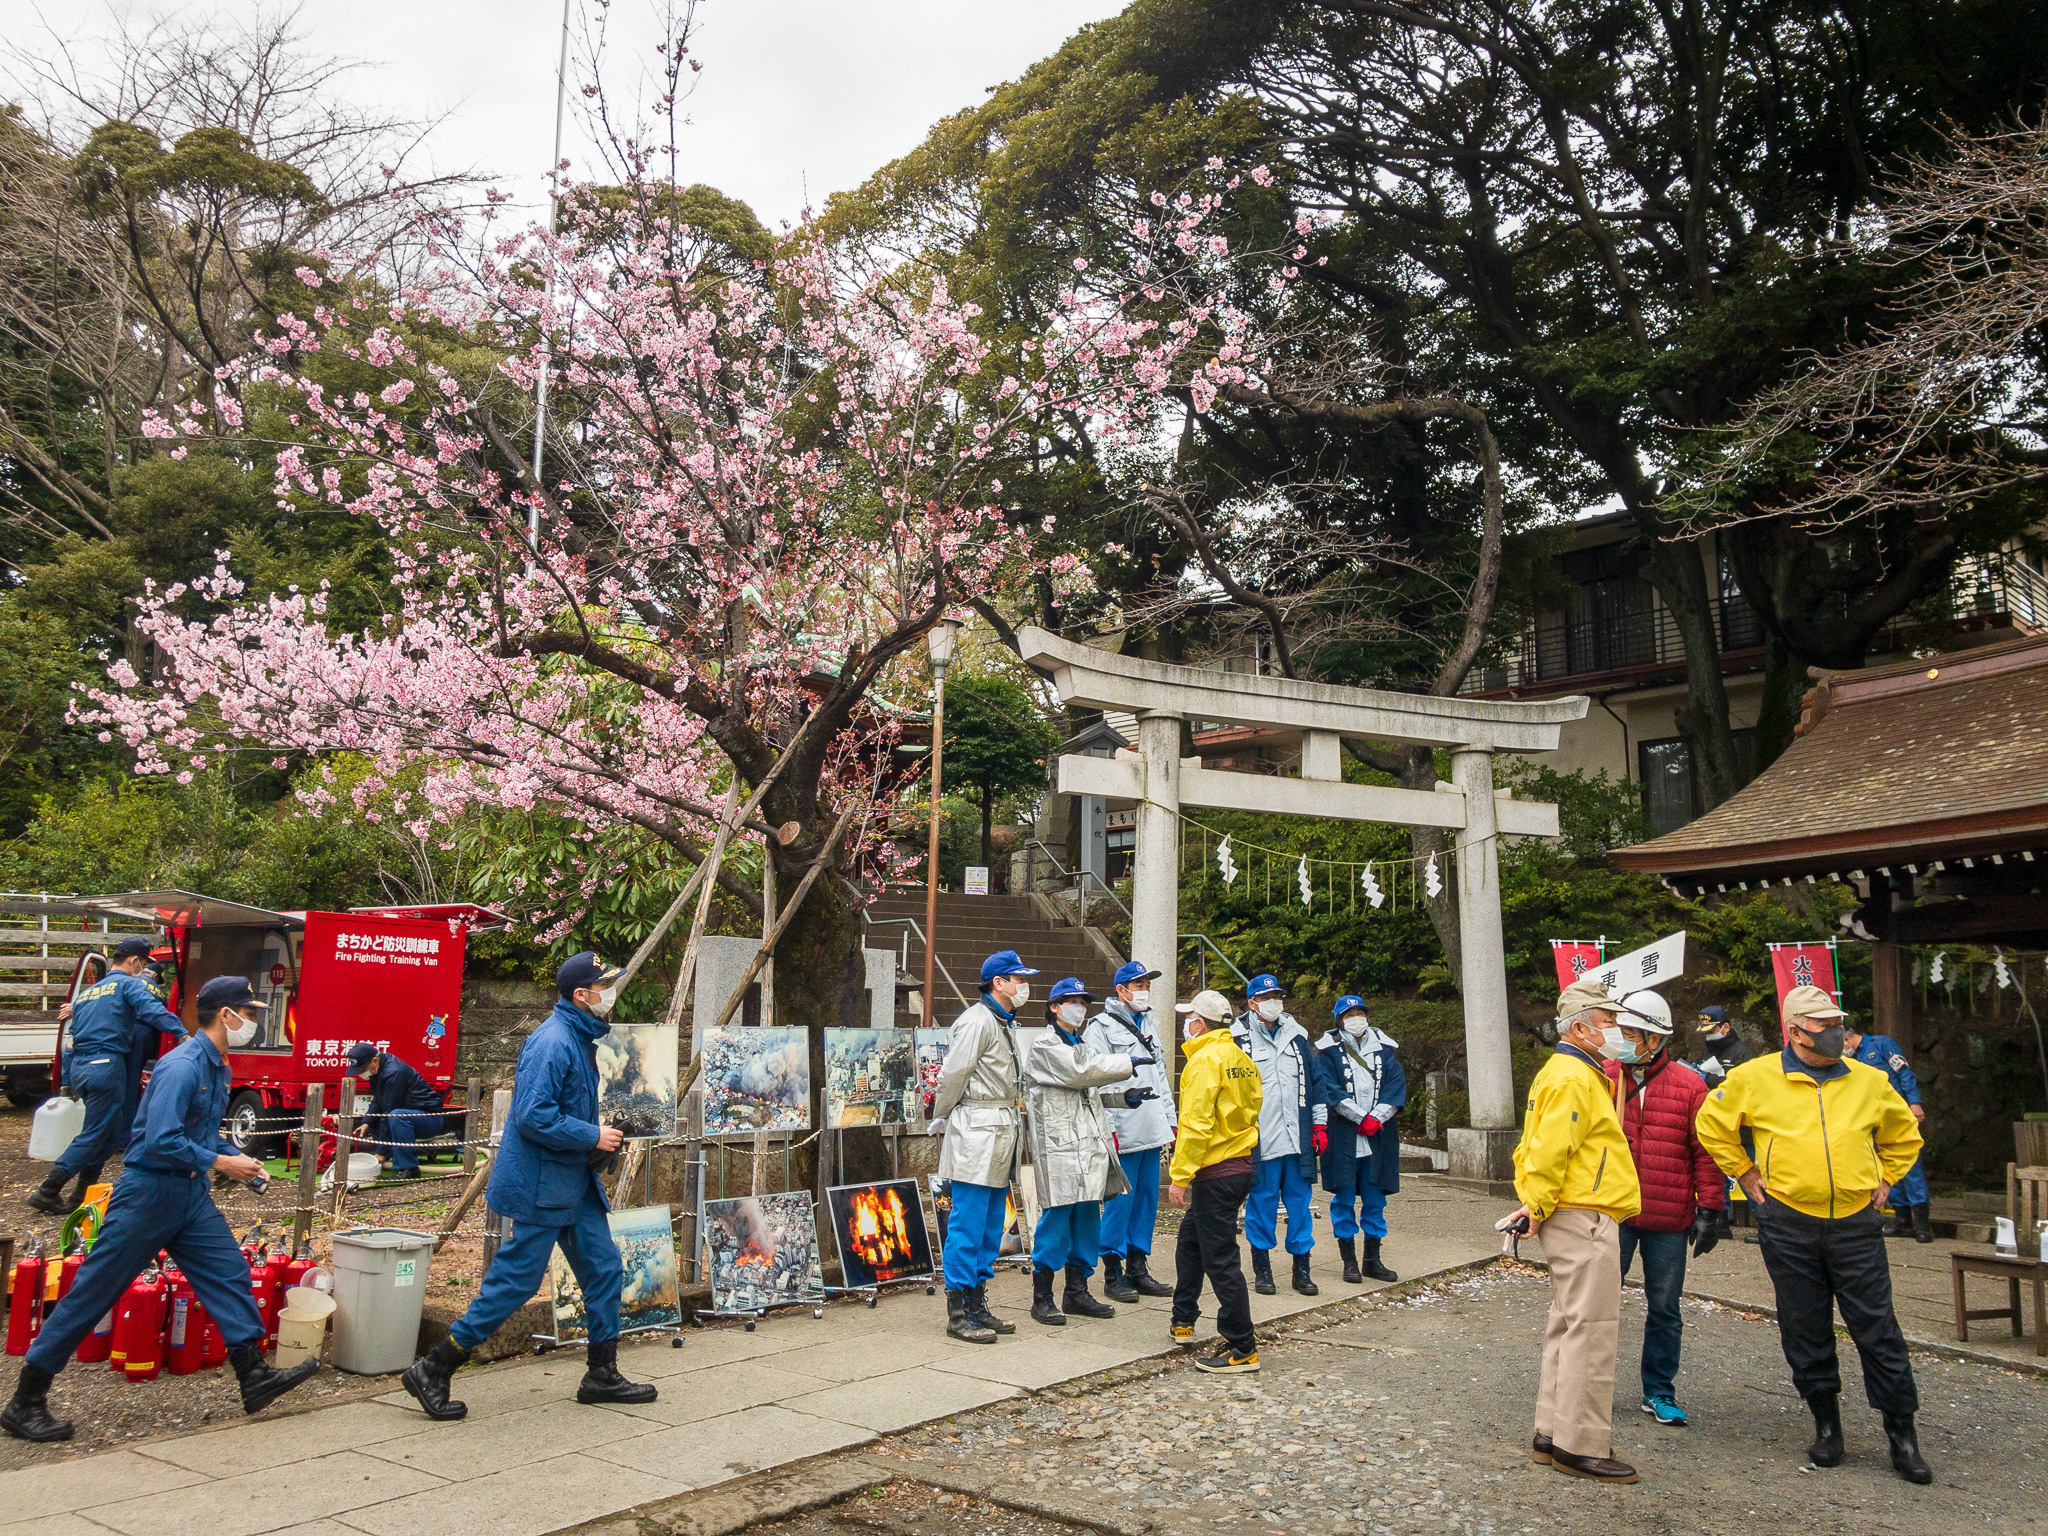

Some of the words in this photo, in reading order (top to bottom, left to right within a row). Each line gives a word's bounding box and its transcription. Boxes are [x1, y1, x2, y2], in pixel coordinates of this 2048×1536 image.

[336, 932, 440, 955] まちかど防災訓練車
[335, 951, 352, 962] Fire
[353, 952, 387, 965] Fighting
[389, 954, 421, 966] Training
[423, 956, 438, 966] Van
[272, 969, 285, 979] 119
[305, 1038, 391, 1056] 東京消庁
[305, 1057, 339, 1068] TOKYO
